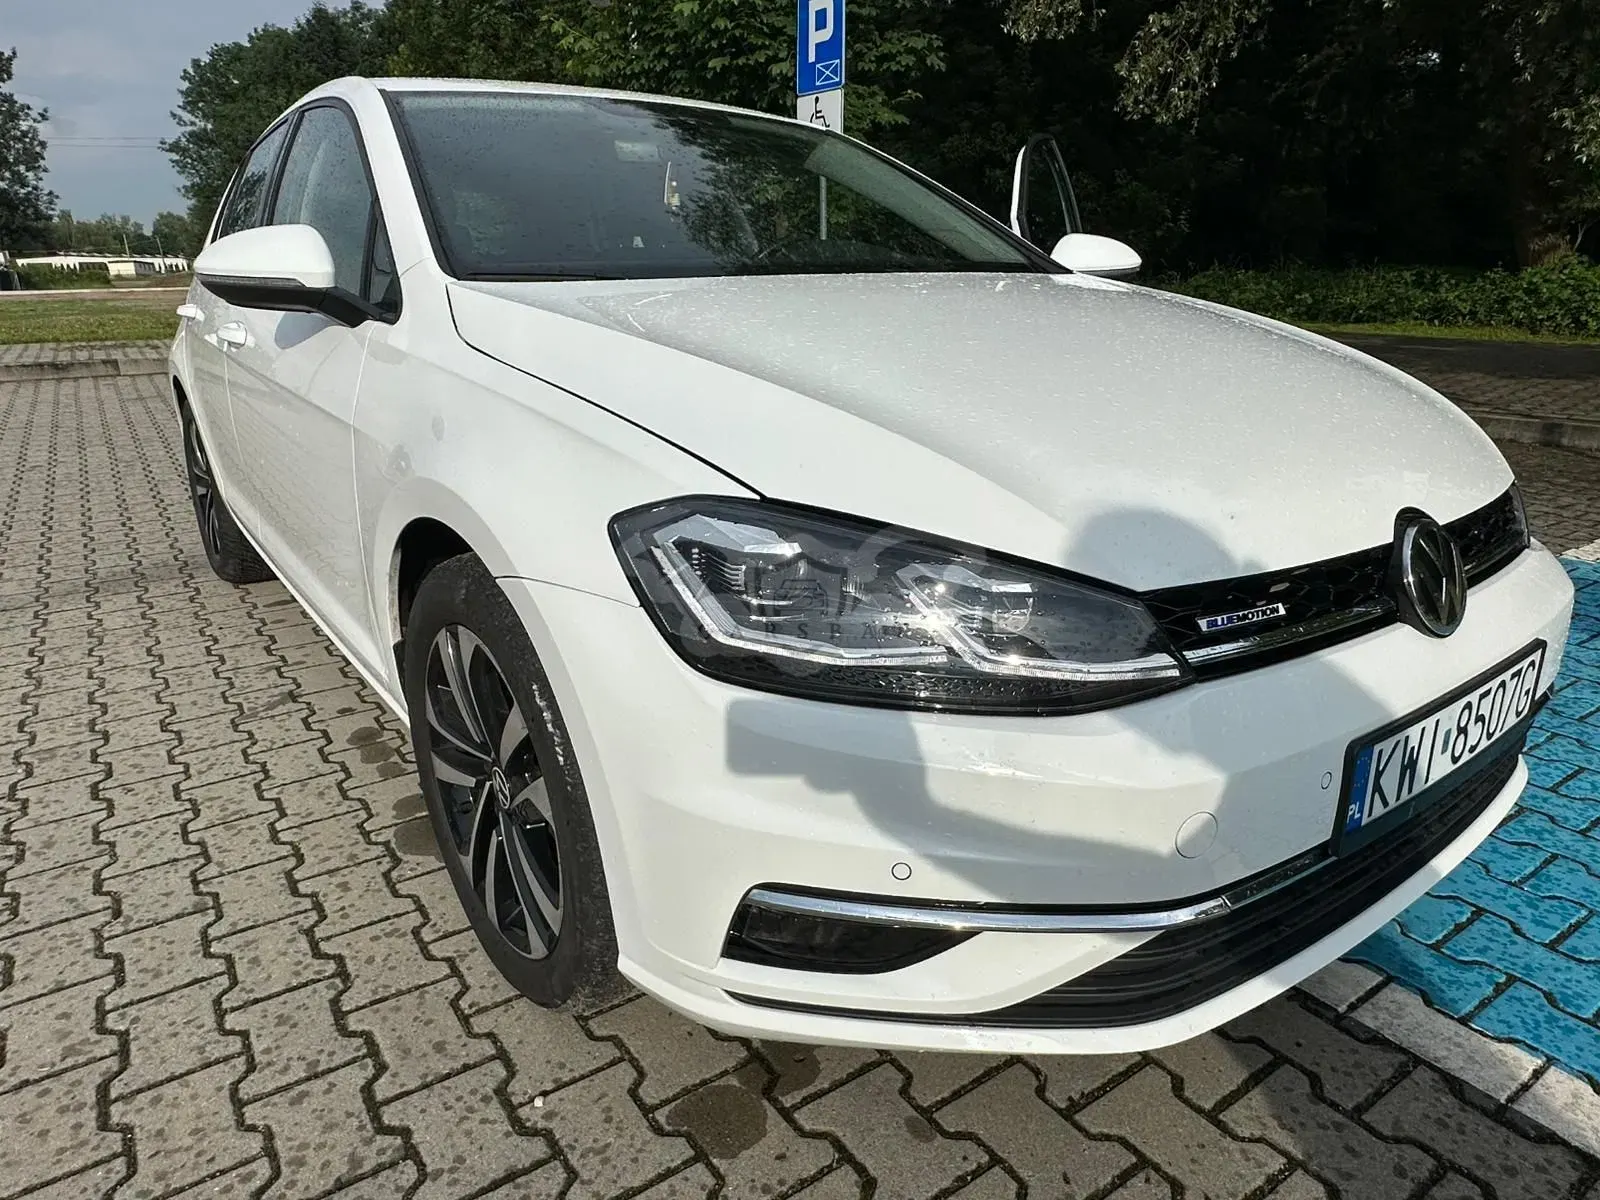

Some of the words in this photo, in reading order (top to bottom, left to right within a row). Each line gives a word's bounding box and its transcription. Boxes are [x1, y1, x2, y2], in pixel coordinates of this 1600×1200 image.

[808, 0, 834, 63] P
[1206, 605, 1280, 629] BLUEMOTION
[1367, 718, 1440, 818] KWI
[1450, 659, 1536, 765] 8507G
[1346, 803, 1361, 823] PL
